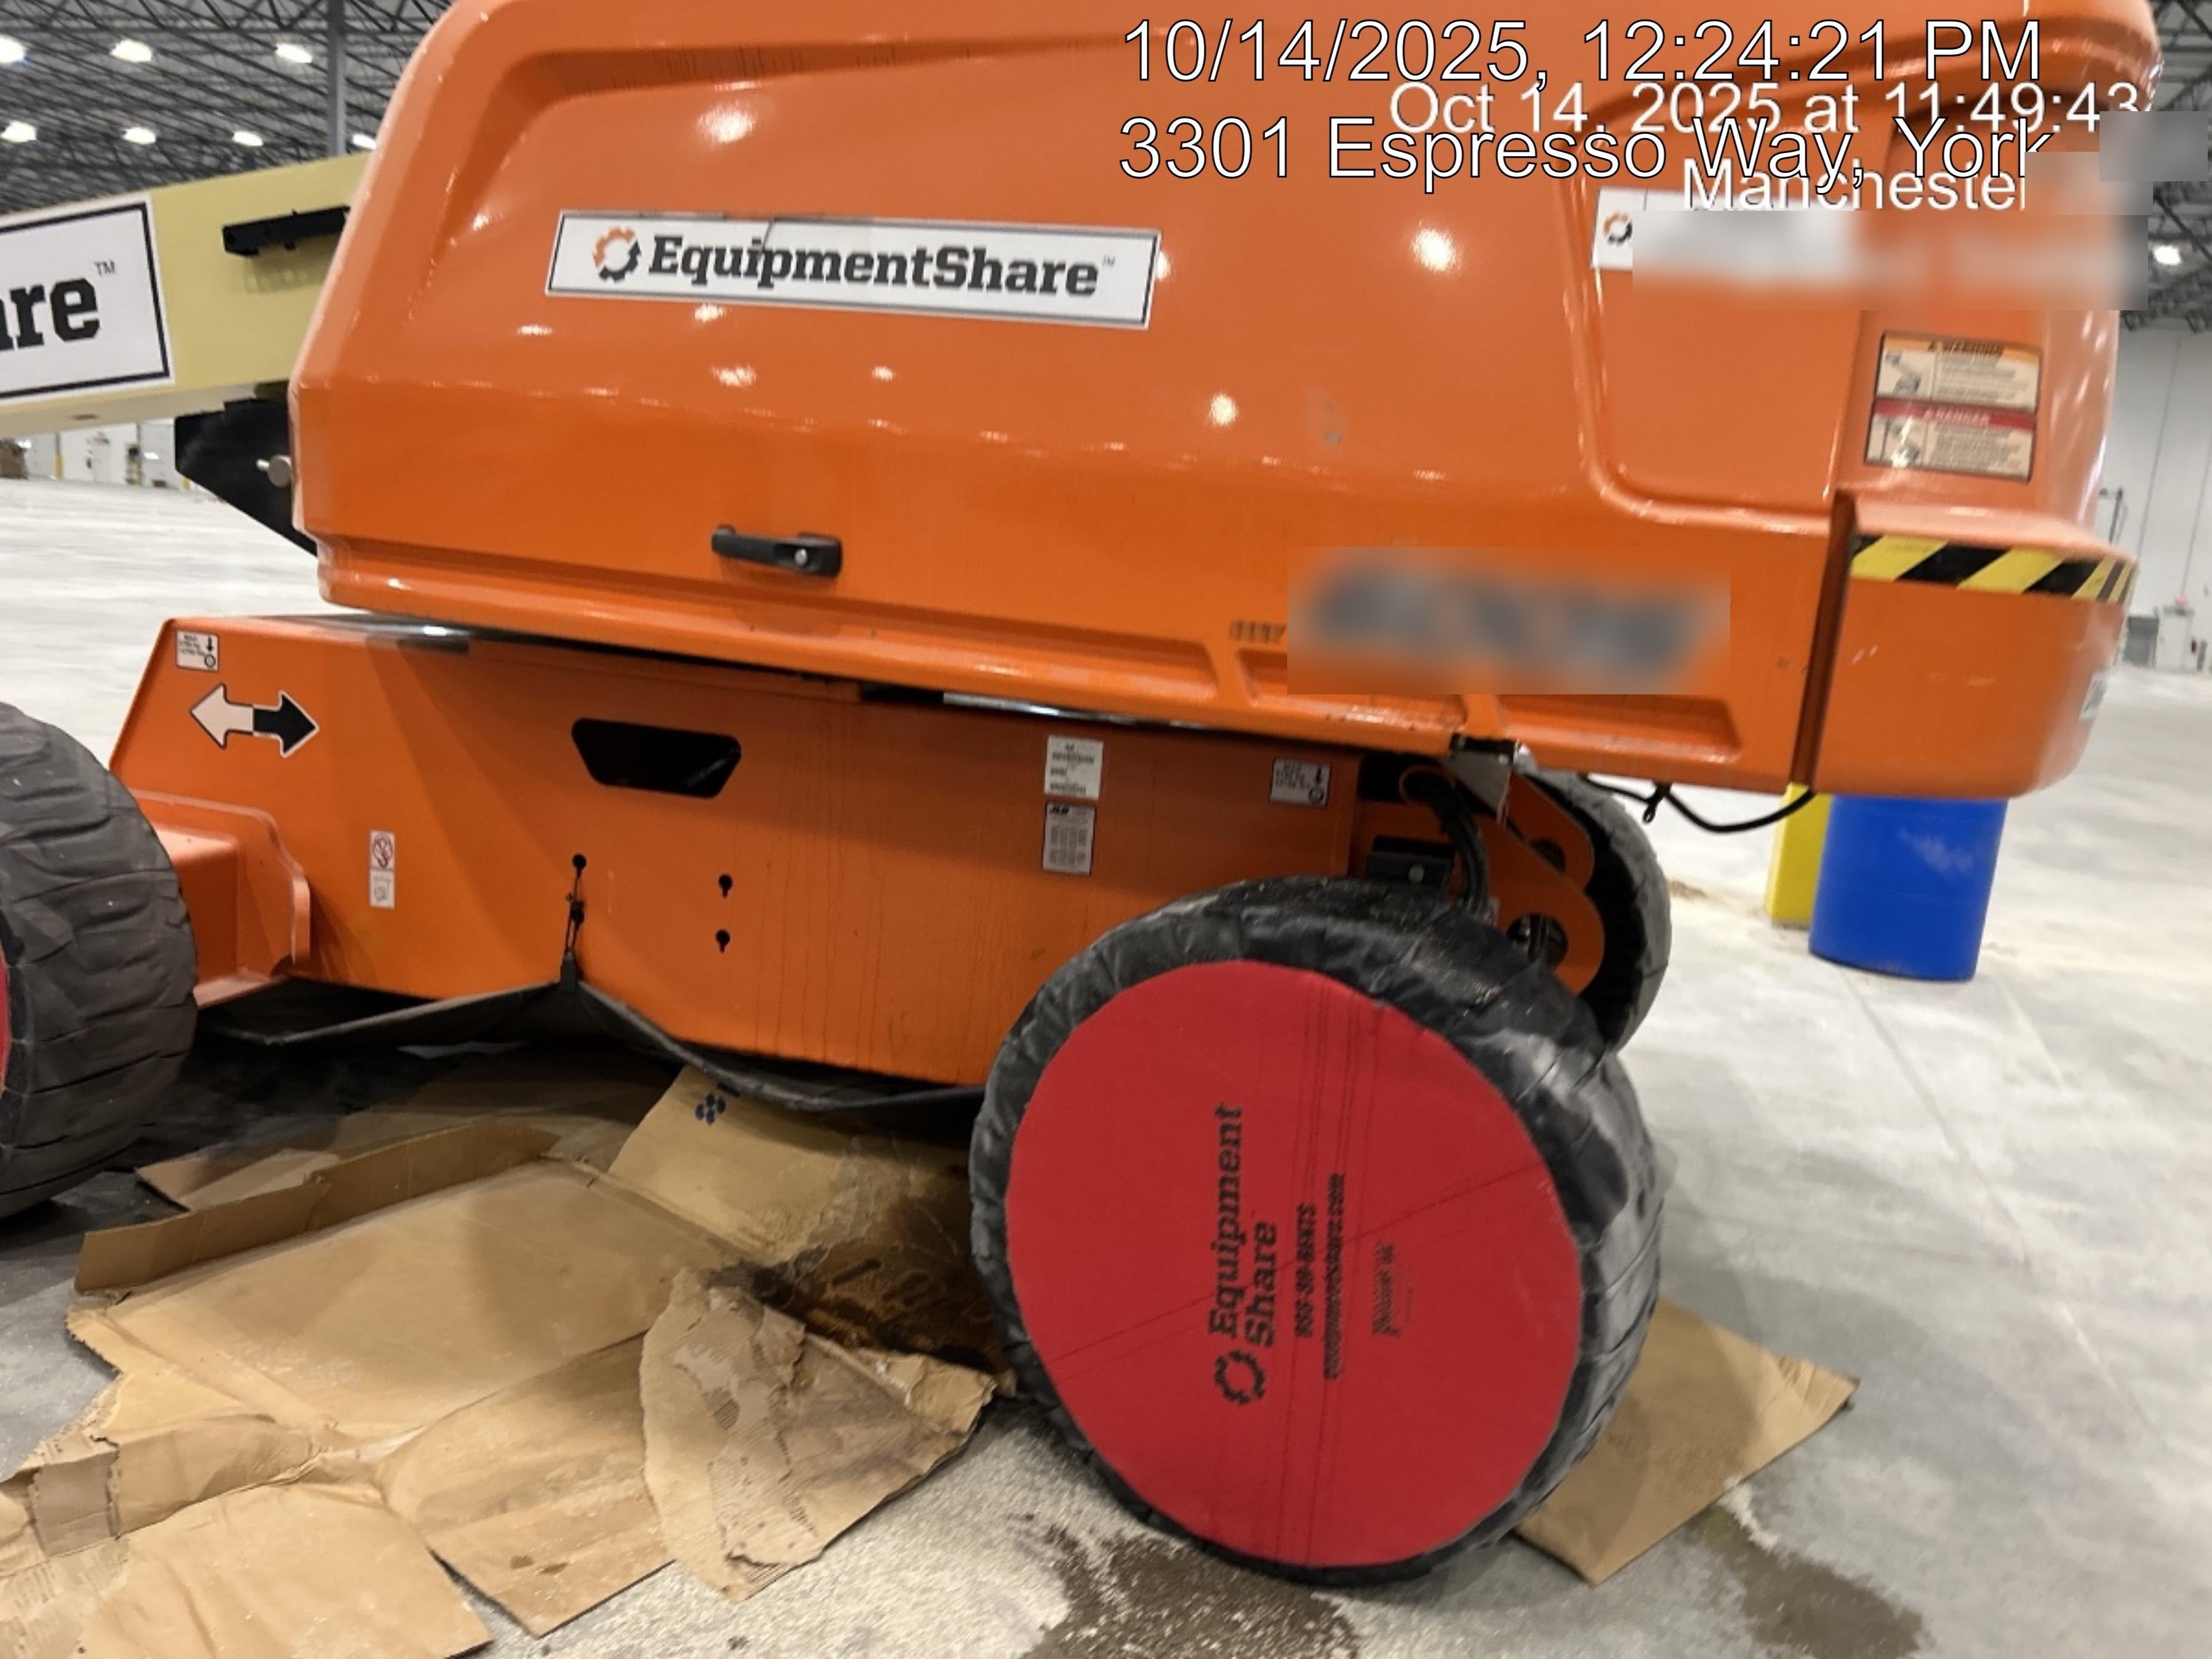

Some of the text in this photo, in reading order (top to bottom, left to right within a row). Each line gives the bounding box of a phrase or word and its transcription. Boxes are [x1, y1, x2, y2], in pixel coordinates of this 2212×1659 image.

[648, 235, 1099, 297] EquipmentShare
[1208, 1102, 1247, 1338] Equipment
[1244, 1220, 1278, 1348] Share
